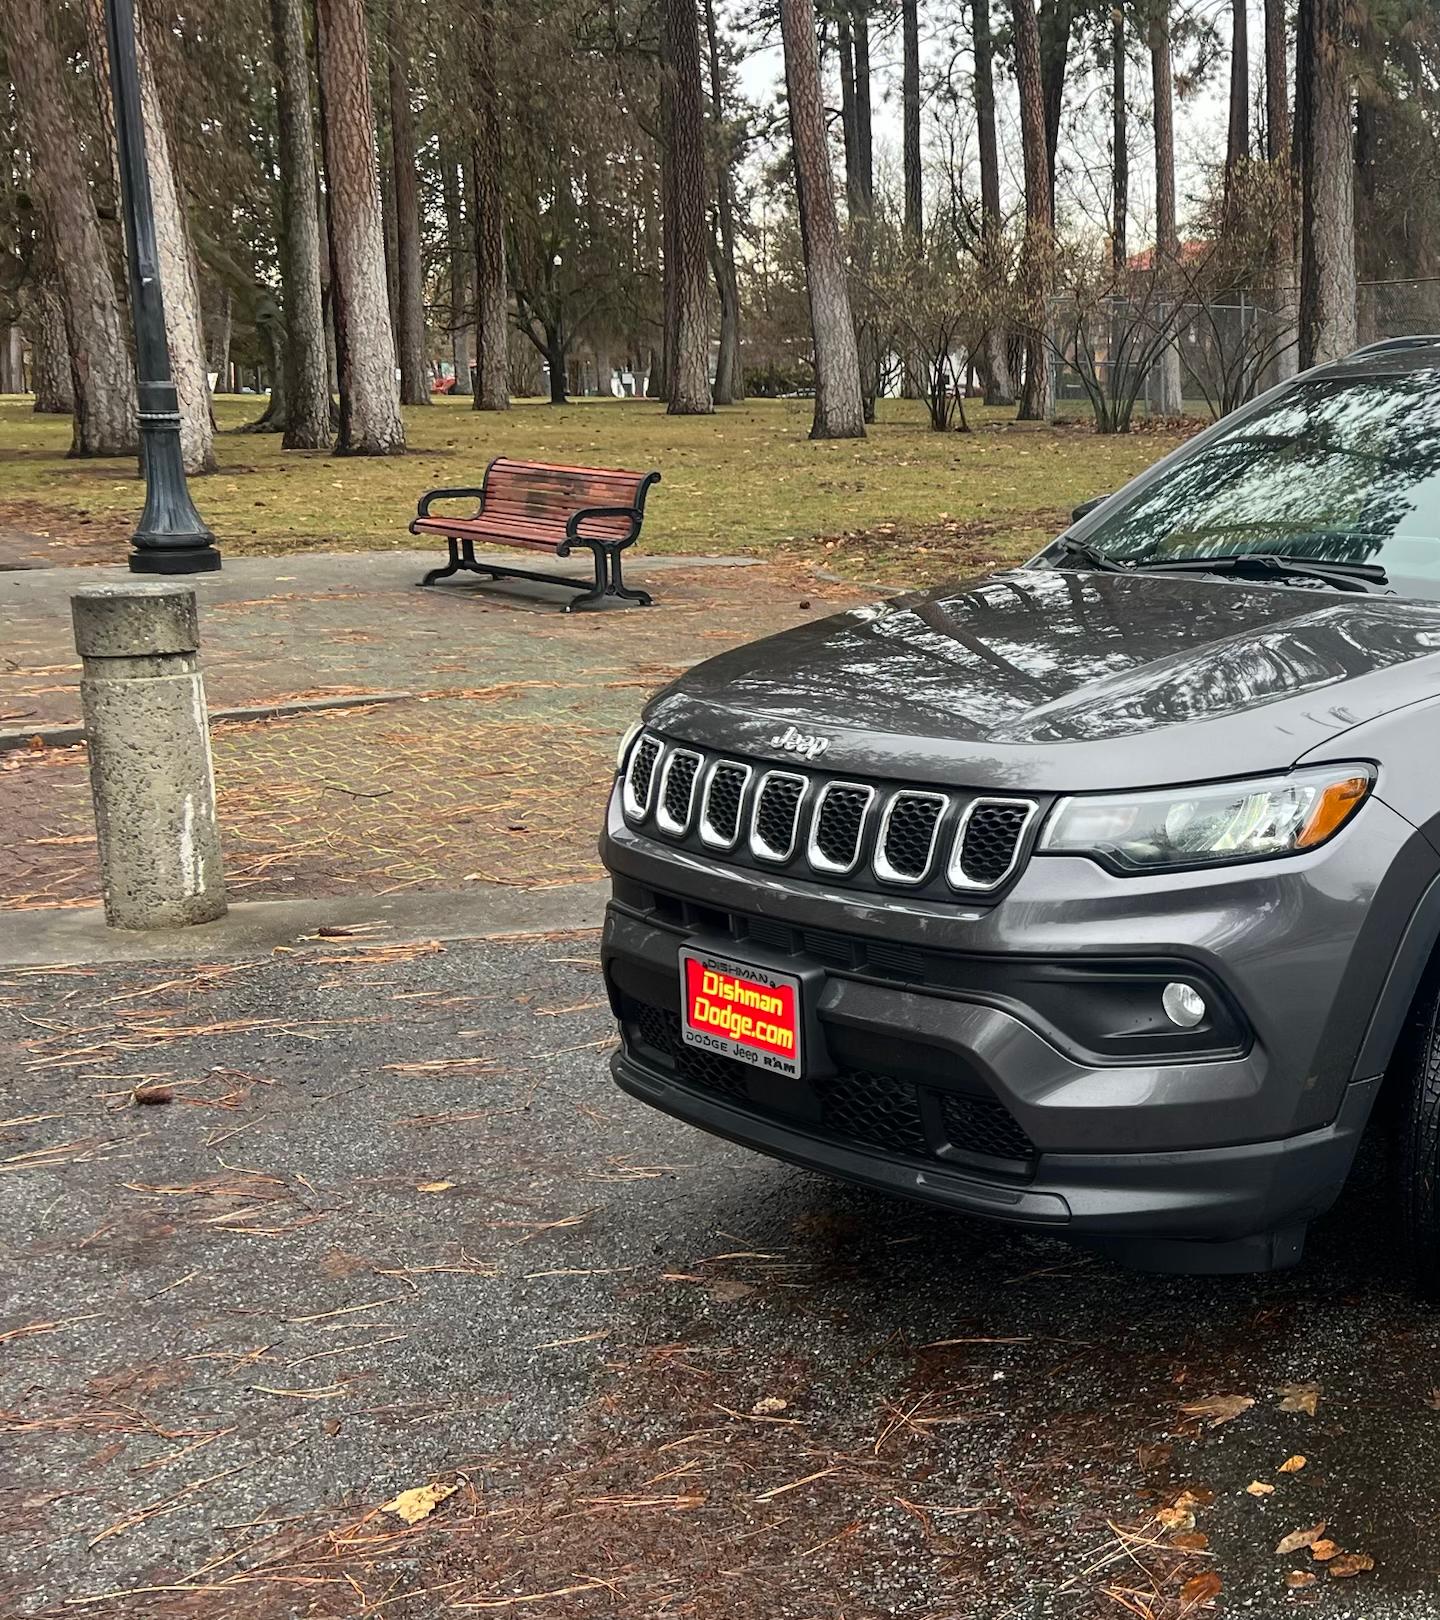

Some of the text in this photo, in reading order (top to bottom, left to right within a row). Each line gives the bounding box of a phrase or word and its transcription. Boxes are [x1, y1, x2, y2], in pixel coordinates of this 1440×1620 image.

[770, 726, 829, 760] Jeep
[702, 970, 783, 1017] Dishman
[706, 959, 768, 984] DISHMAN
[693, 996, 794, 1050] Dodge.com
[686, 1031, 796, 1075] DODGE Jeep RAM
